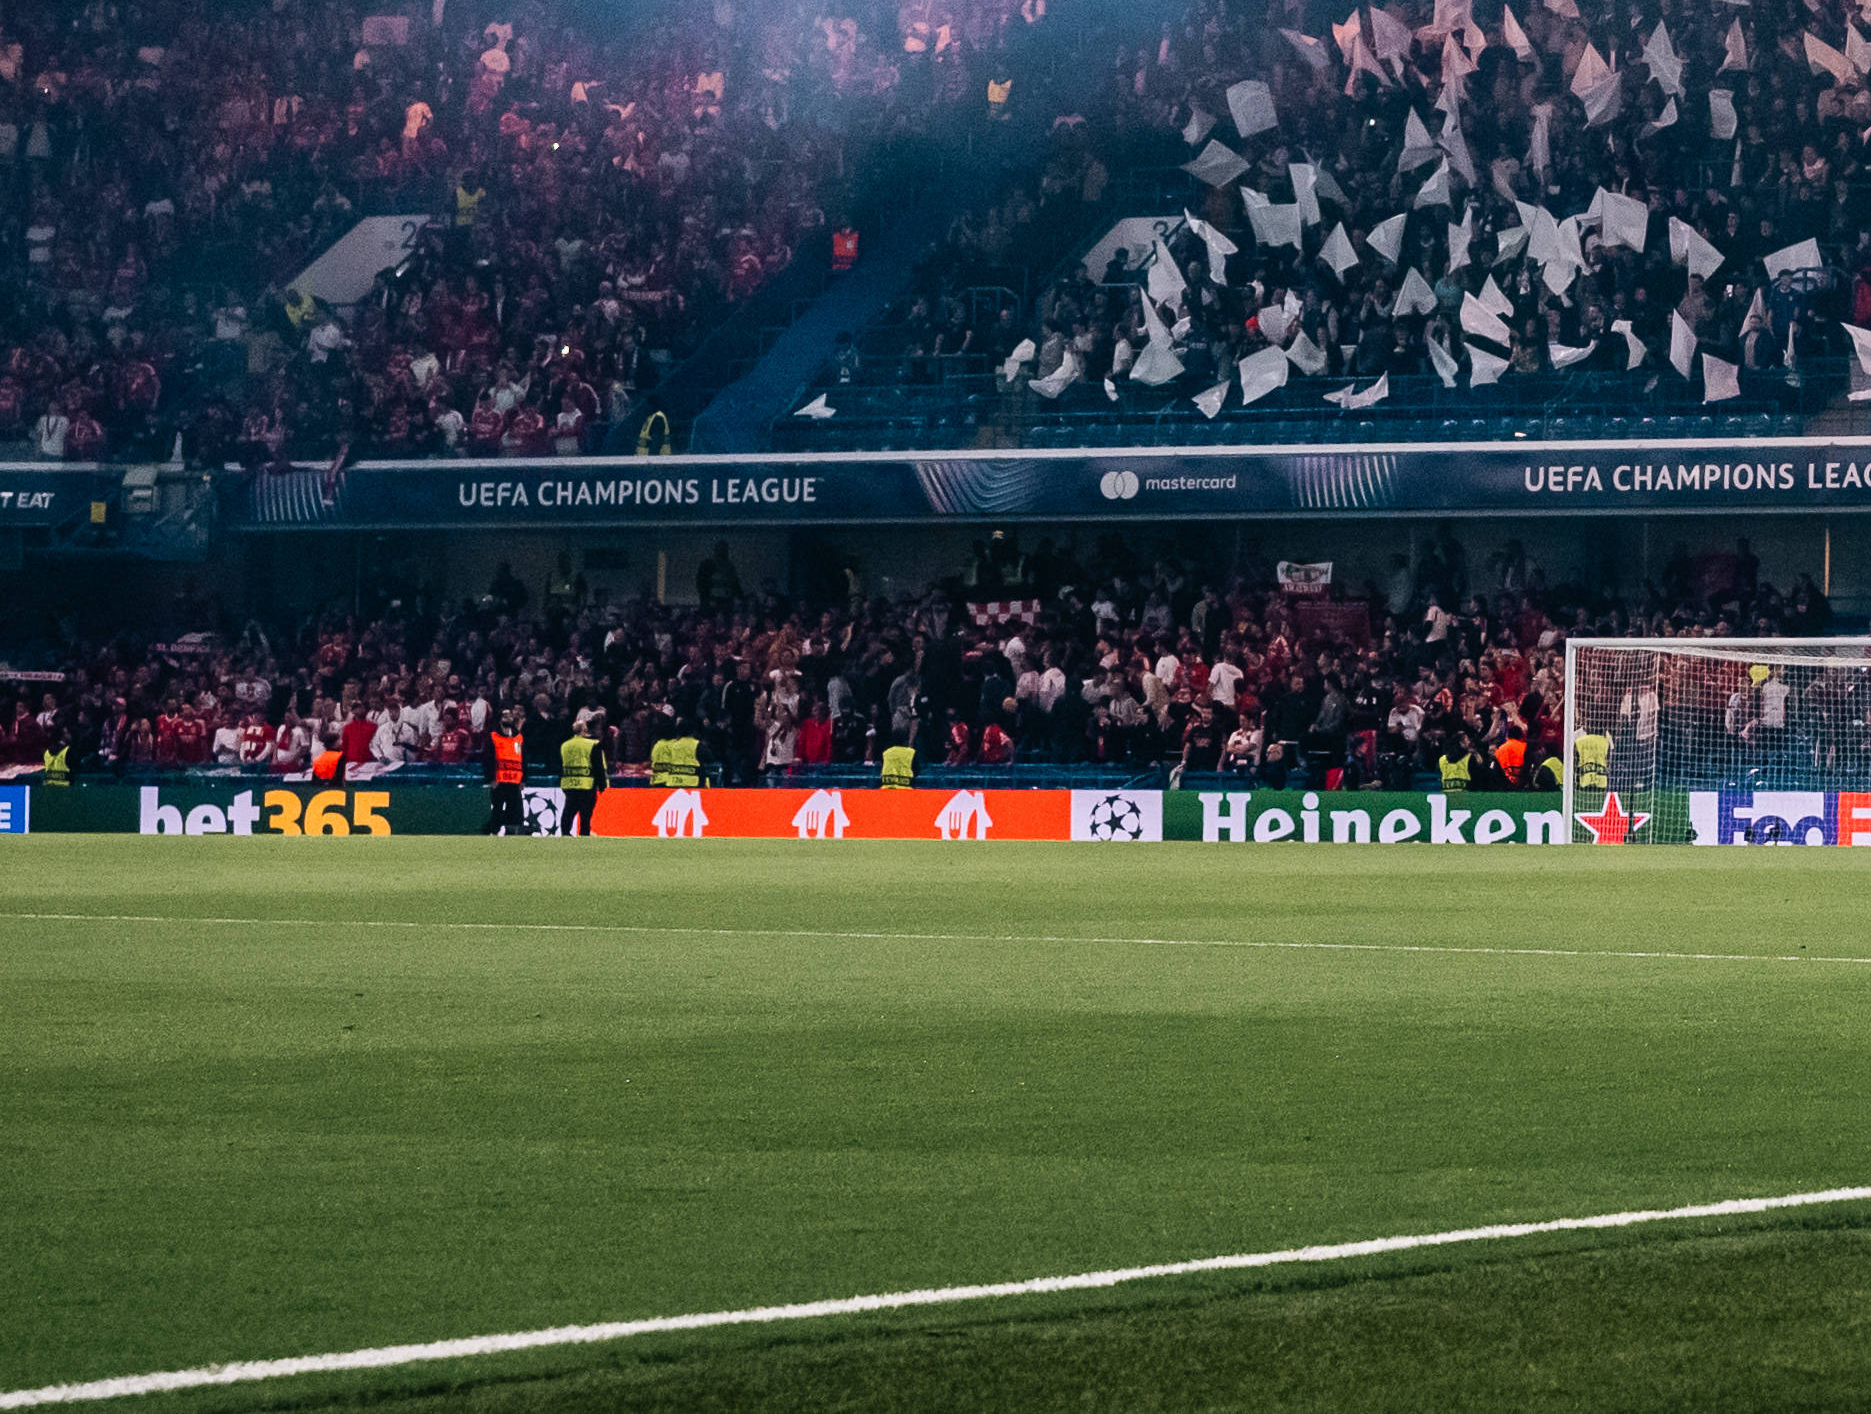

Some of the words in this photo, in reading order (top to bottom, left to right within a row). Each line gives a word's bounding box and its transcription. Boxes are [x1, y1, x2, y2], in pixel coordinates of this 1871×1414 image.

[400, 220, 417, 250] 2
[458, 482, 529, 507] UEFA
[537, 479, 699, 507] CHAMPIONS
[712, 476, 818, 504] LEAGUE
[1146, 474, 1237, 492] mastercard
[1524, 465, 1602, 493] UEFA
[1613, 463, 1794, 492] CHAMPIONS
[16, 491, 55, 510] EAT
[139, 785, 392, 836] bet365
[1198, 791, 1566, 845] Heineken
